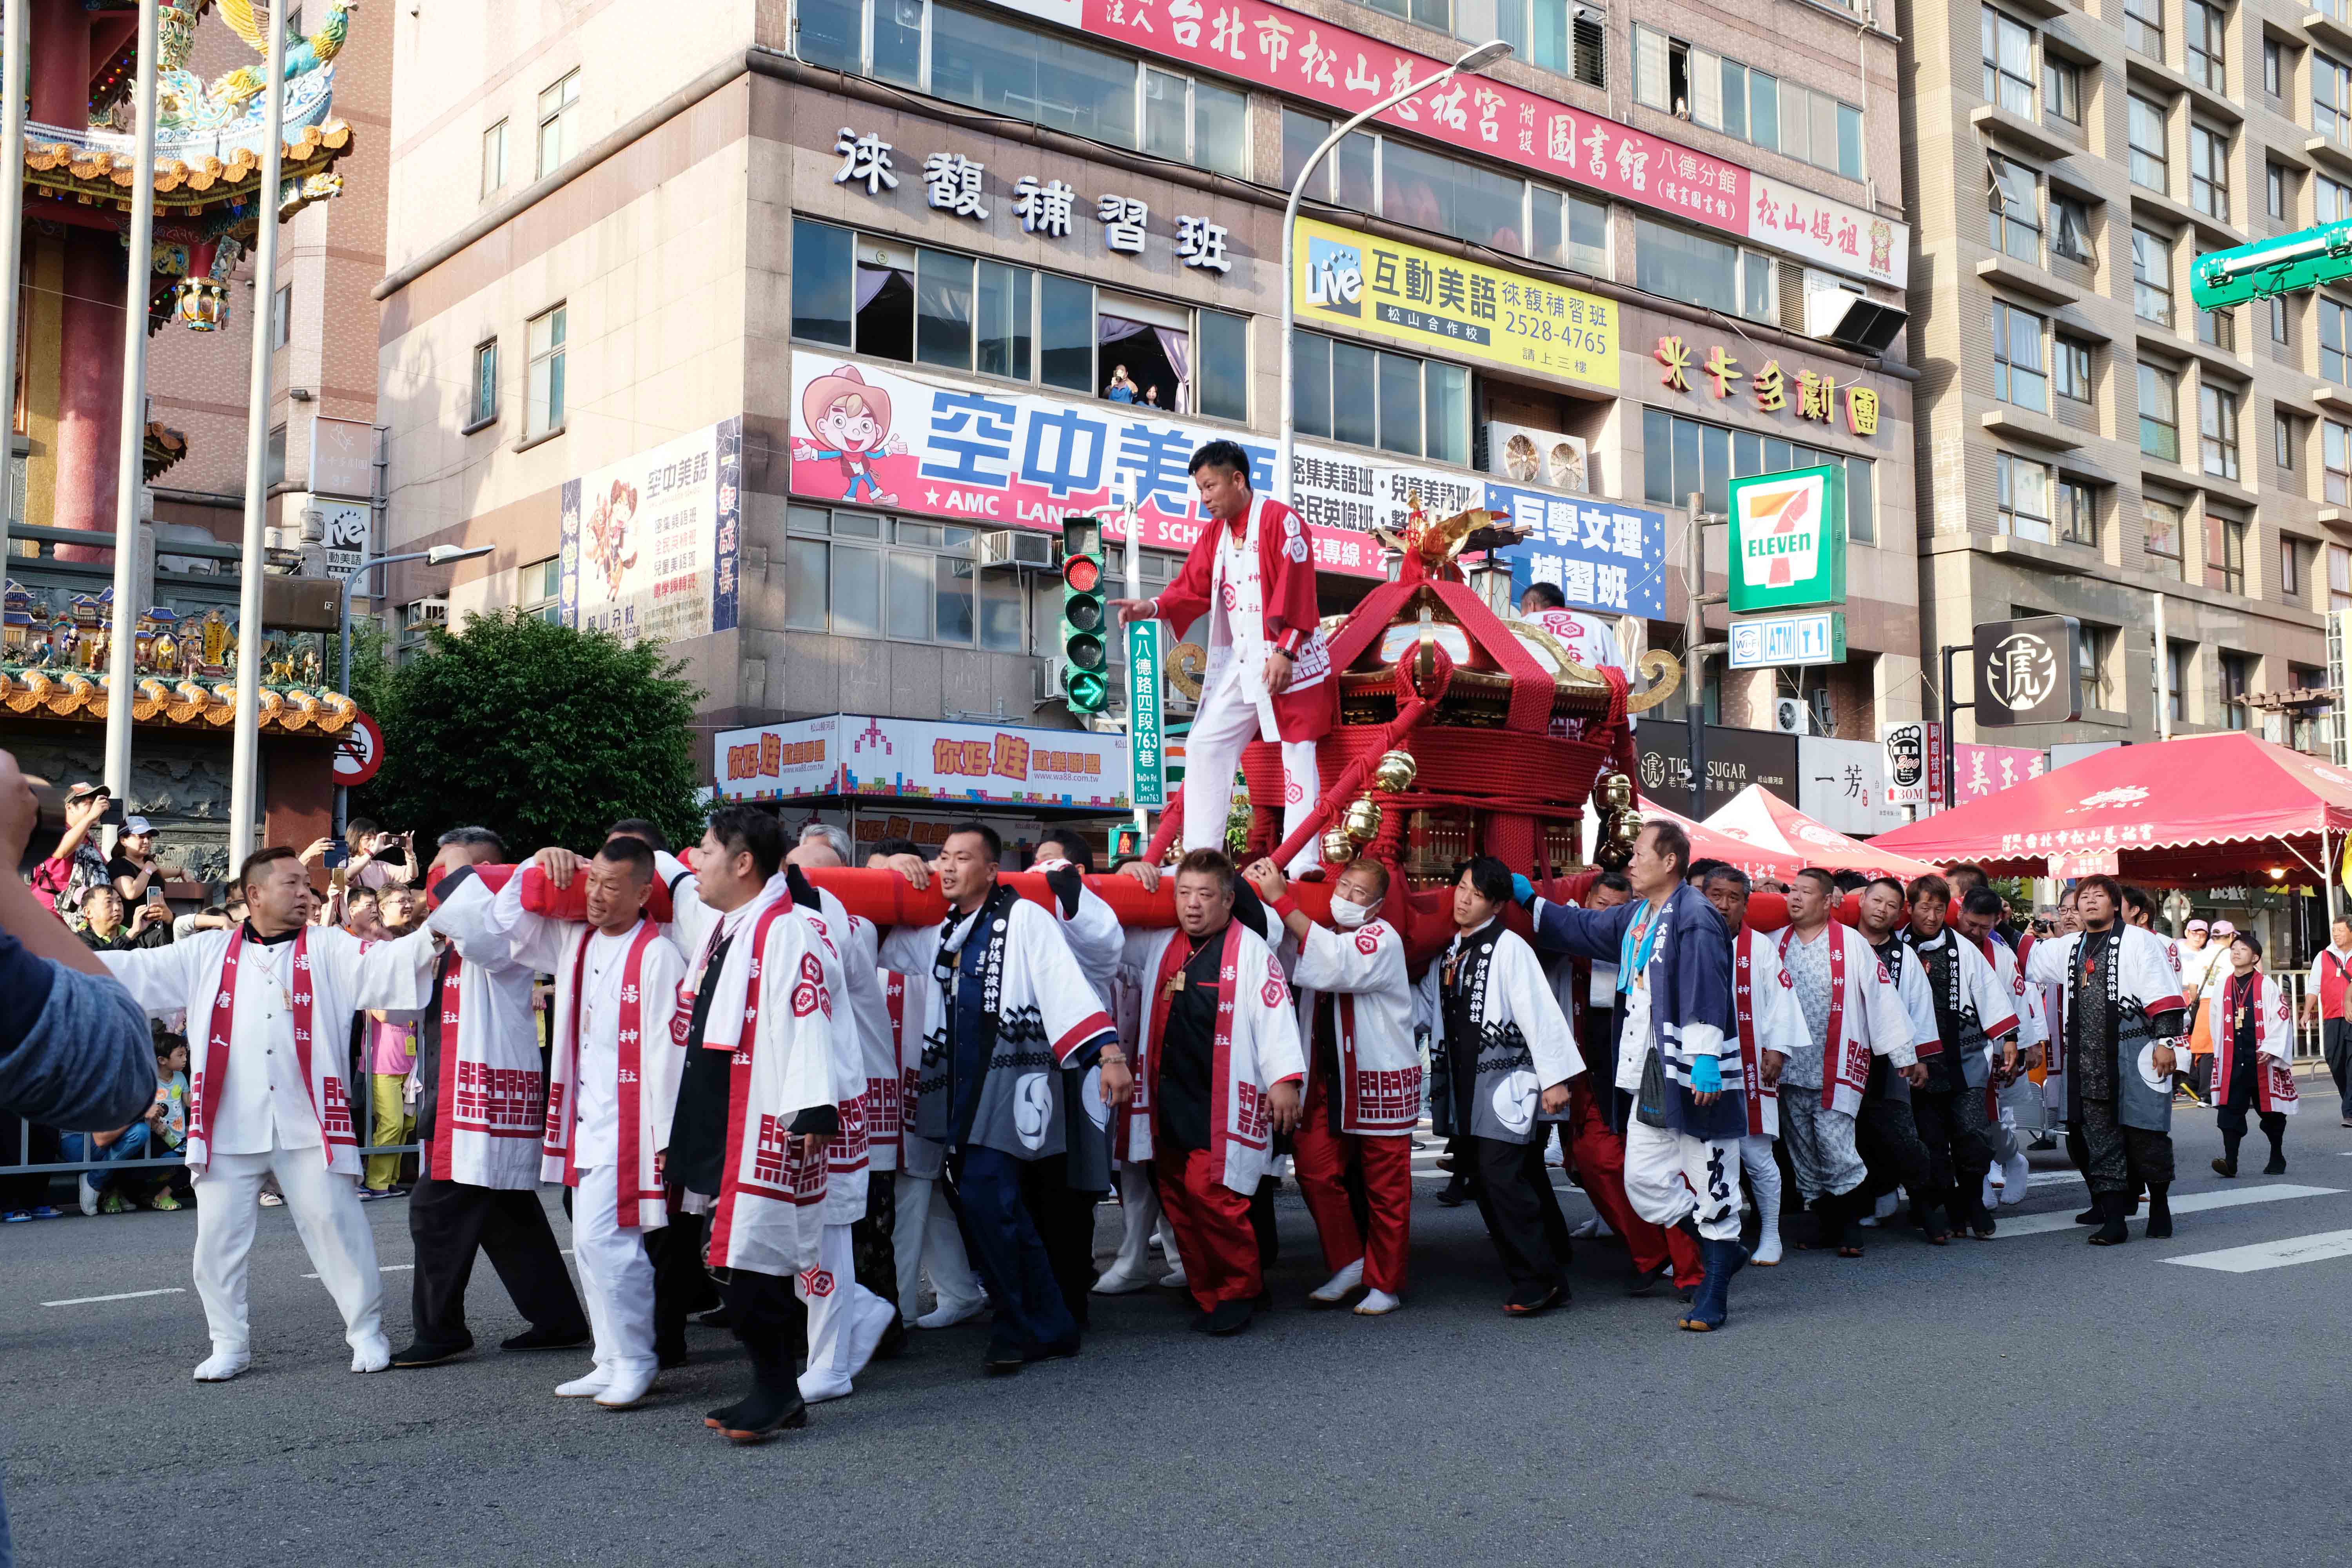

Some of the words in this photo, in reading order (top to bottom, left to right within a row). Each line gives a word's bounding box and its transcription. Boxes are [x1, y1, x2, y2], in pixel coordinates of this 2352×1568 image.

[1518, 102, 1535, 156] 附設
[1548, 115, 1649, 191] 圖書館
[1657, 147, 1737, 196] 八德分館
[1756, 188, 1859, 257] 松山媽祖
[1305, 260, 1365, 304] Live
[1372, 249, 1497, 322] 互動美語
[1868, 269, 1892, 279] MATSU
[1387, 307, 1478, 341] 松山合作校
[1505, 311, 1606, 355] 2528-4765
[1522, 347, 1587, 374] 請上三樓
[1653, 335, 1879, 436] 米卡多劇團
[647, 451, 709, 499] 空中美語
[655, 506, 697, 534] 密集美語班
[944, 490, 1000, 516] AMC
[1016, 499, 1144, 537] LANAGE
[1513, 494, 1642, 559] 巨學文理
[653, 550, 697, 577] 兒童美語班
[655, 529, 697, 555] 全民英檢班
[1530, 552, 1628, 610] 補習班
[1769, 626, 1792, 657] ATM
[1134, 639, 1158, 768] 八德路四段763巷
[728, 732, 781, 780] 你好娃
[782, 739, 825, 766] 歡樂聯盟
[783, 763, 824, 774] www.wa88.com.tw
[933, 732, 1030, 782] 你好娃
[1032, 750, 1101, 775] 歡樂聯盟
[1707, 761, 1747, 779] SUGAR
[1896, 755, 1920, 769] 200
[1033, 773, 1099, 783] www.wa88.com.tw
[1136, 773, 1150, 782] BaDe
[1136, 793, 1159, 802] Lane763
[1141, 784, 1154, 792] Sec.4
[1757, 775, 1784, 785] 松山饒河店
[1815, 764, 1862, 798] 一芳
[1898, 788, 1923, 800] 30M
[1650, 922, 1668, 963] 大唐人
[293, 953, 311, 1042] 湯神社
[984, 937, 1004, 1013] 伊佐爾波神社
[1469, 958, 1489, 1023] 伊佐爾波神社
[1737, 956, 1751, 1021] 湯神社
[1831, 949, 1844, 1013] 湯神社
[1949, 961, 1959, 1011] 伊佐爾波神社
[2106, 947, 2118, 1001] 伊佐爾波神社
[442, 975, 461, 1024] 神社
[1215, 965, 1237, 1046] 湯神社
[618, 984, 639, 1083] 湯神社
